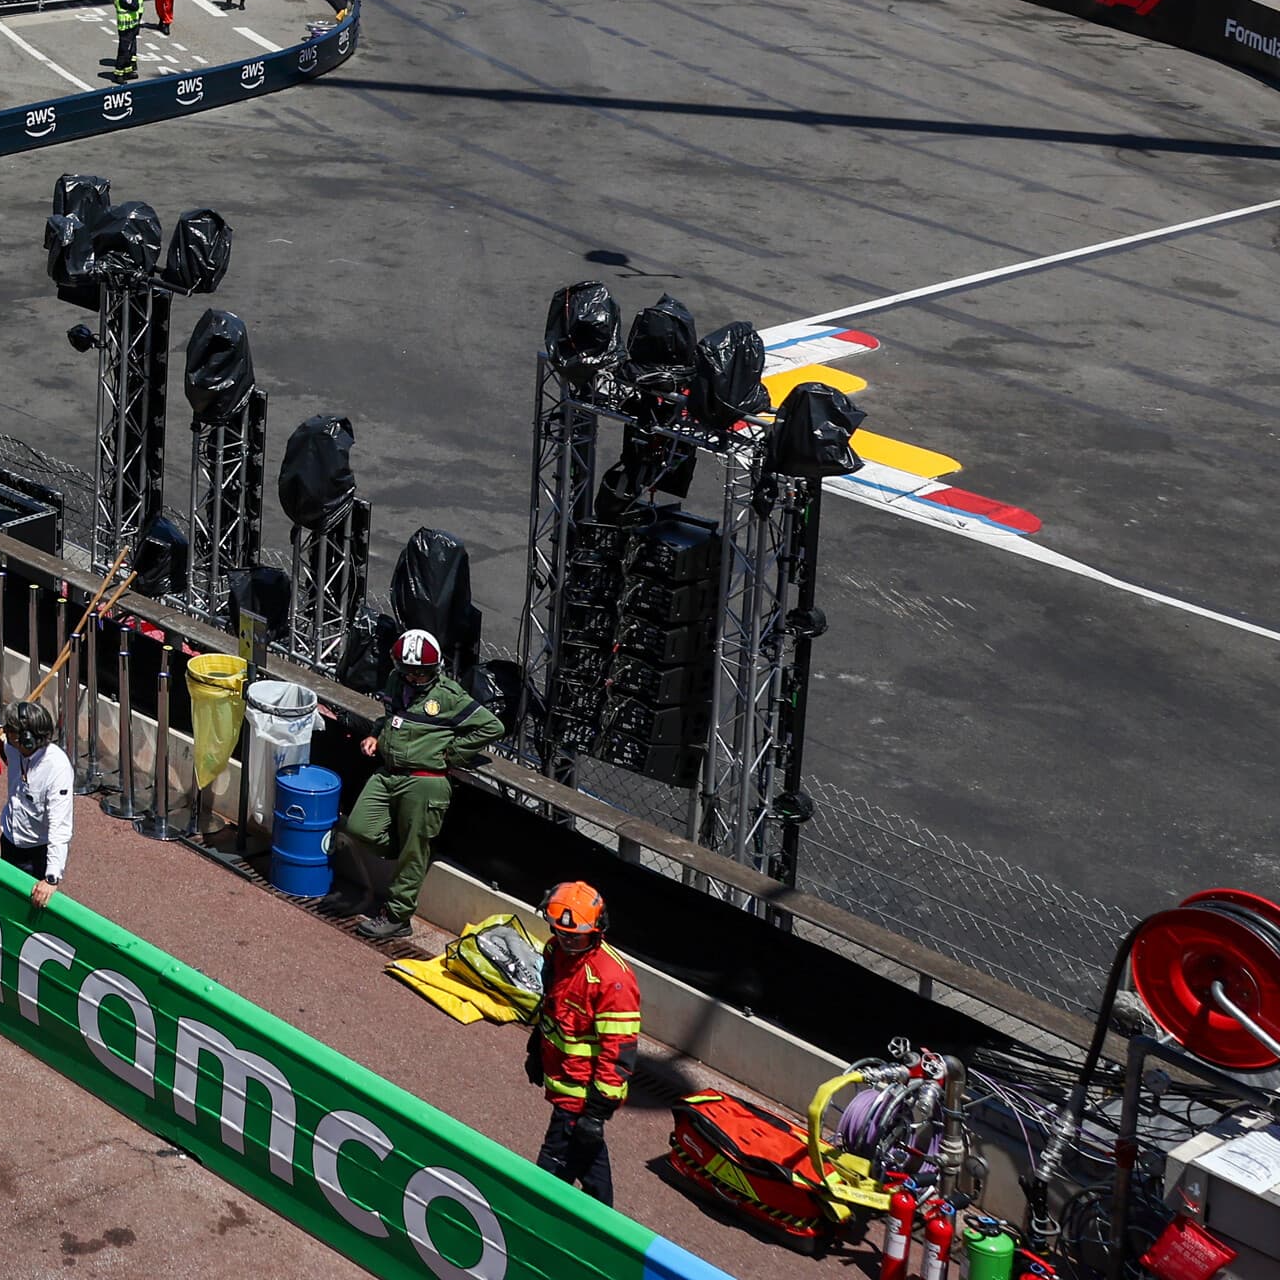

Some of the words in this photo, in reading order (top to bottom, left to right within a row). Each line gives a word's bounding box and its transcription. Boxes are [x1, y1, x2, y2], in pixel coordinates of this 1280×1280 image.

[299, 46, 319, 65] aws
[241, 61, 265, 80] aws
[177, 77, 204, 97] aws
[103, 91, 133, 110] aws
[26, 107, 56, 126] aws
